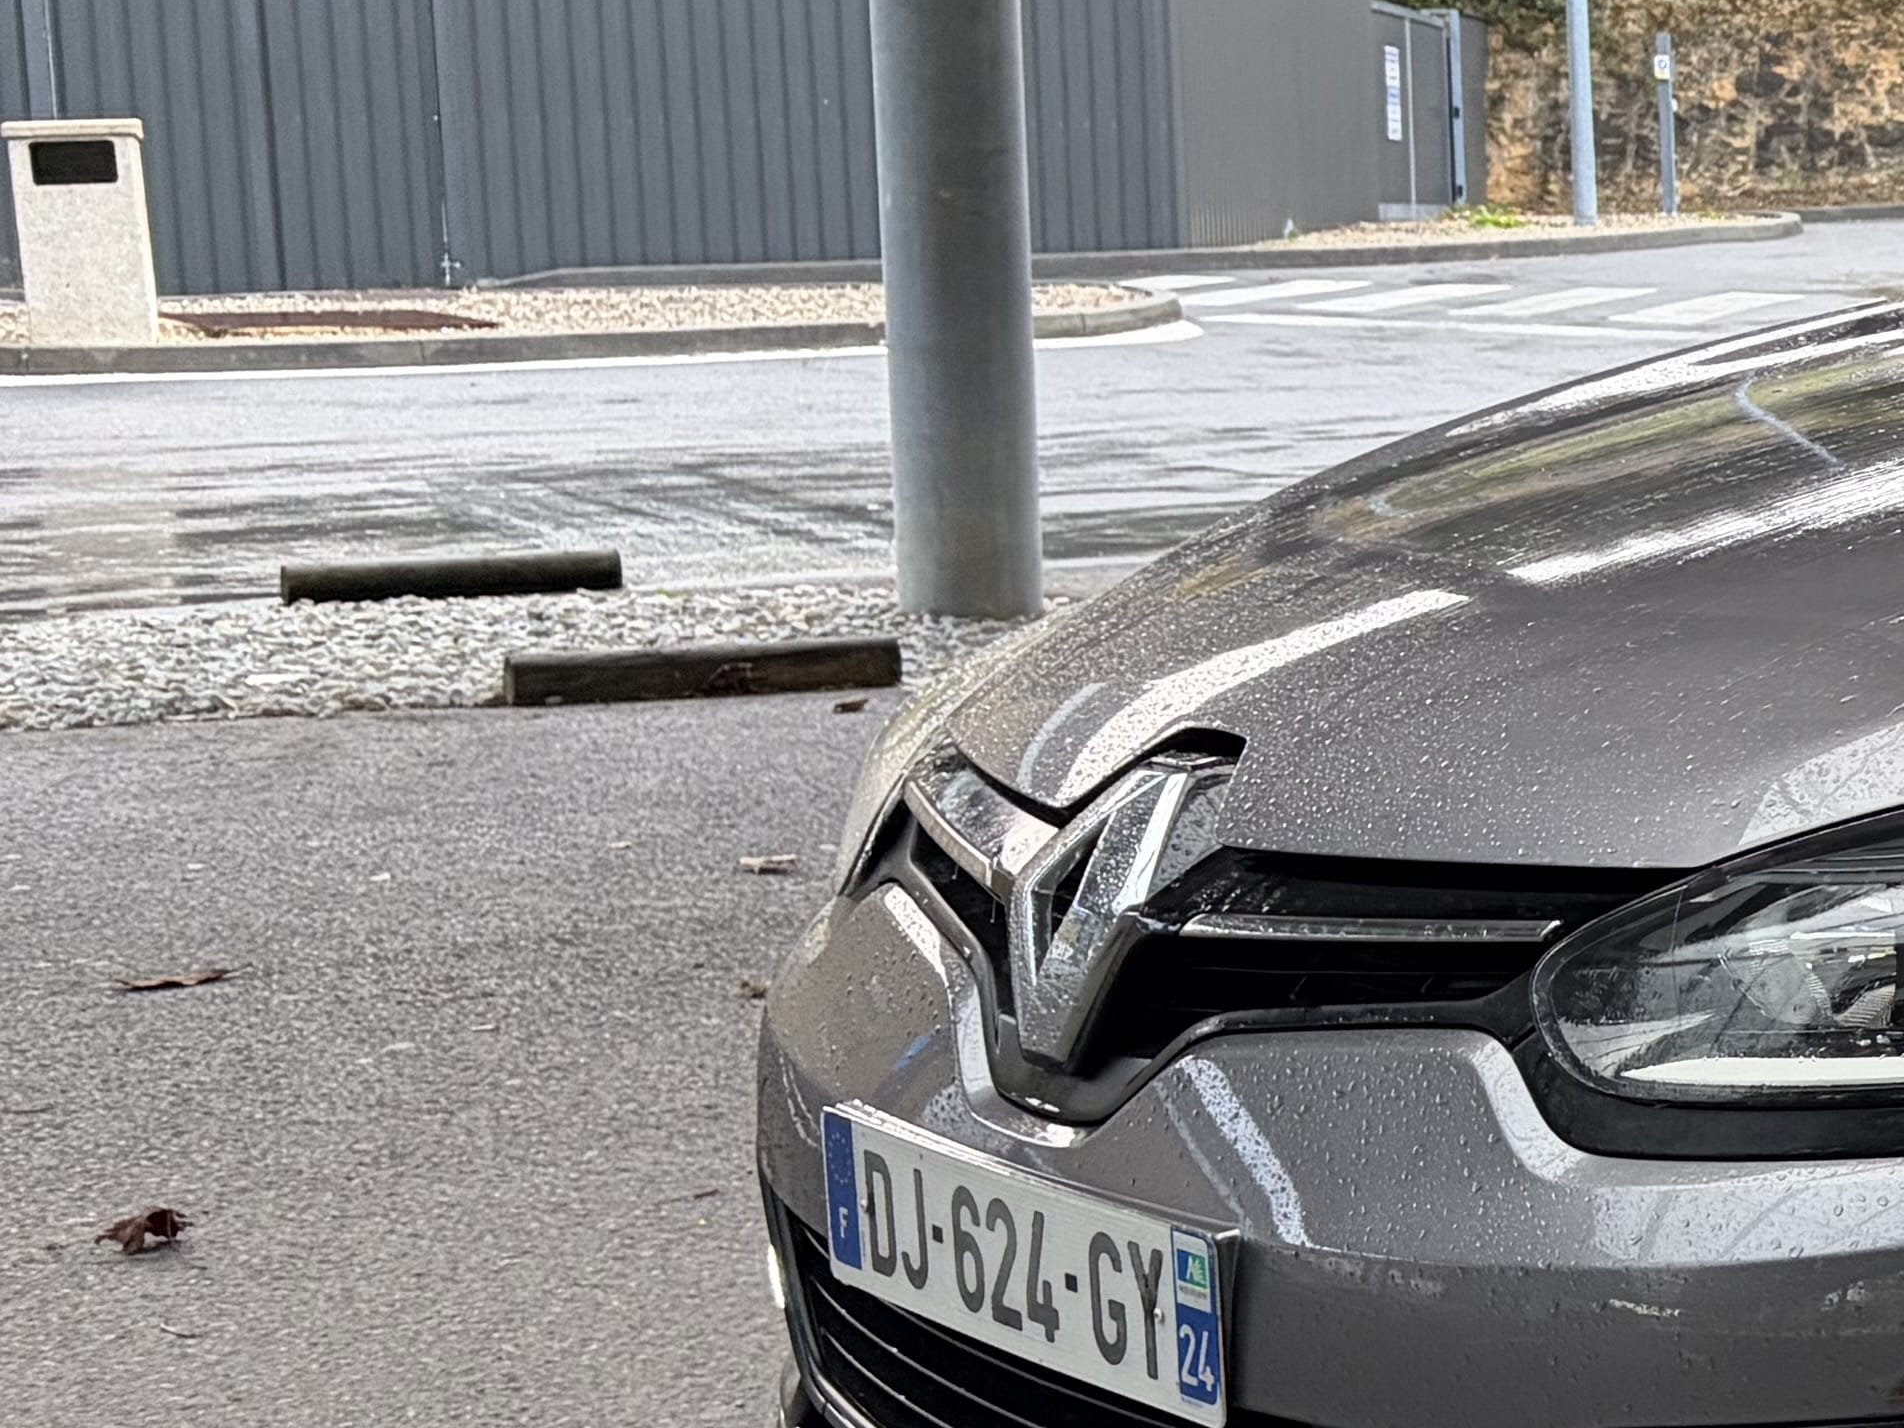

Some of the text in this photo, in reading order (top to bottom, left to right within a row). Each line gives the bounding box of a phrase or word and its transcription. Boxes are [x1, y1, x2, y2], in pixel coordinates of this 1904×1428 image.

[838, 1206, 849, 1239] F
[864, 1149, 1163, 1380] DJ-624-GY
[1179, 1323, 1215, 1392] 24
